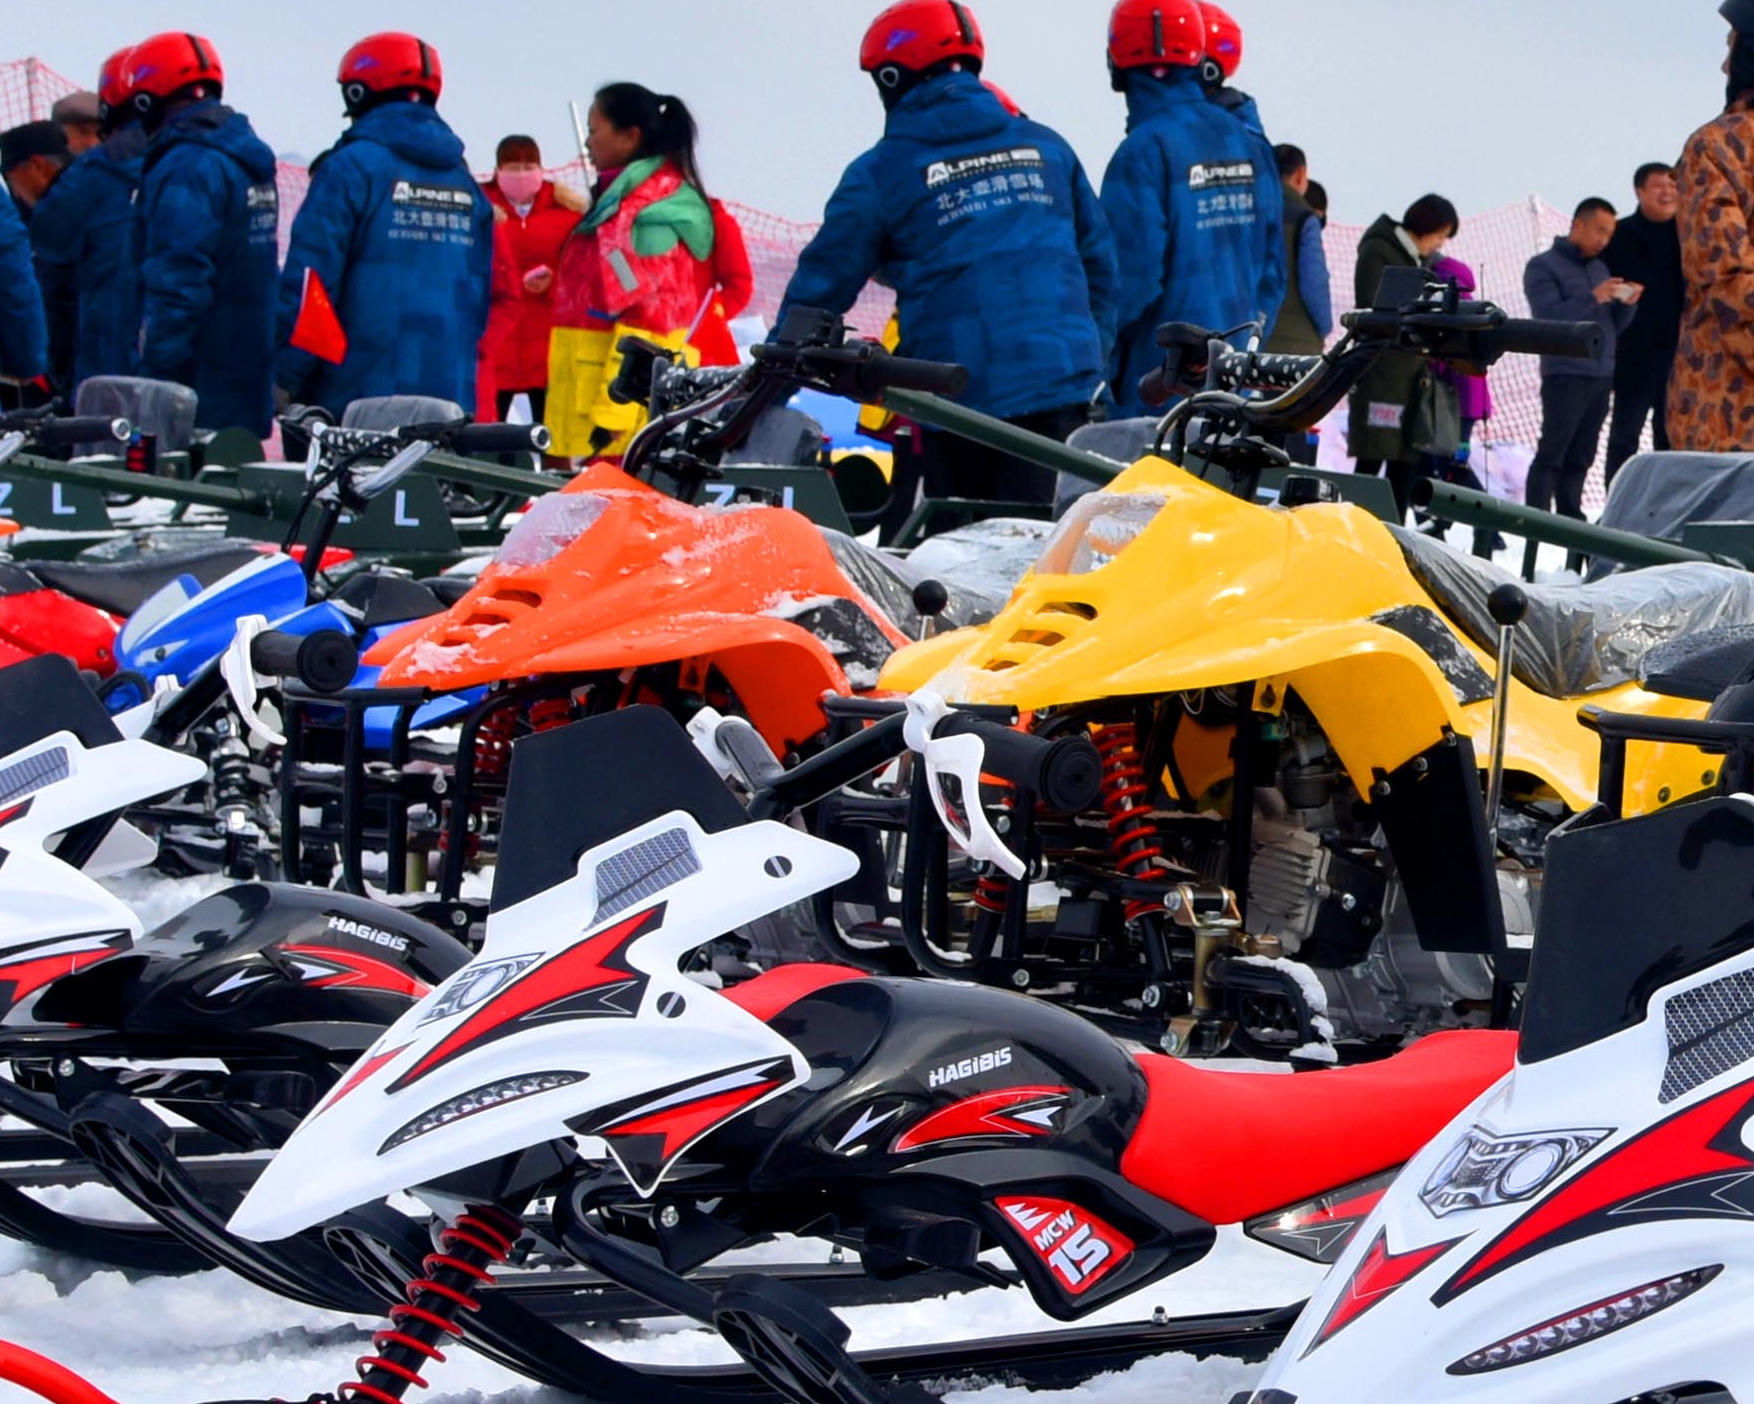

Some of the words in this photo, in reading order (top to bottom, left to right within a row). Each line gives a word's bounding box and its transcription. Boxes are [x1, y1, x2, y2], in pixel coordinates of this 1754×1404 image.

[927, 152, 1010, 185] ALPINE
[52, 483, 77, 515] L
[394, 489, 419, 527] L
[328, 916, 410, 952] HAGIBIS
[929, 1046, 1013, 1088] HAGIBIS
[1033, 1209, 1075, 1252] MCW
[1047, 1222, 1111, 1286] 15
